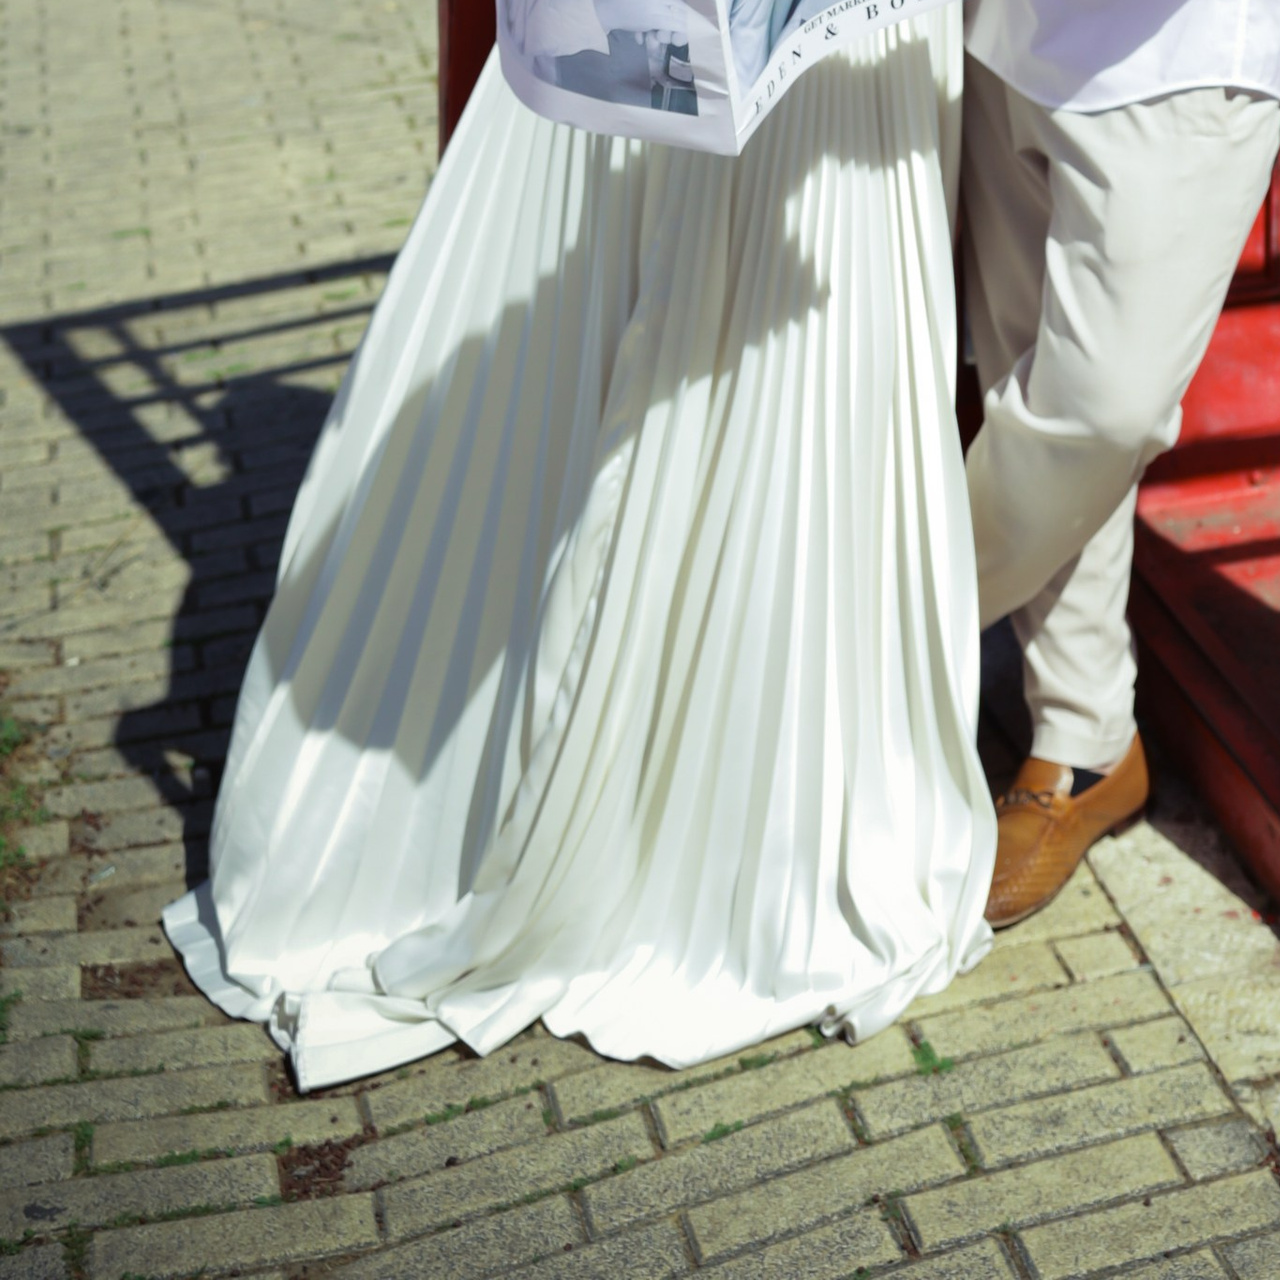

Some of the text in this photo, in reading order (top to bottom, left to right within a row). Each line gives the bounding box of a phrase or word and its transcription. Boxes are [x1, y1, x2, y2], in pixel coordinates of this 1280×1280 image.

[804, 16, 825, 34] GET
[755, 45, 803, 115] EDEN
[825, 23, 839, 40] &
